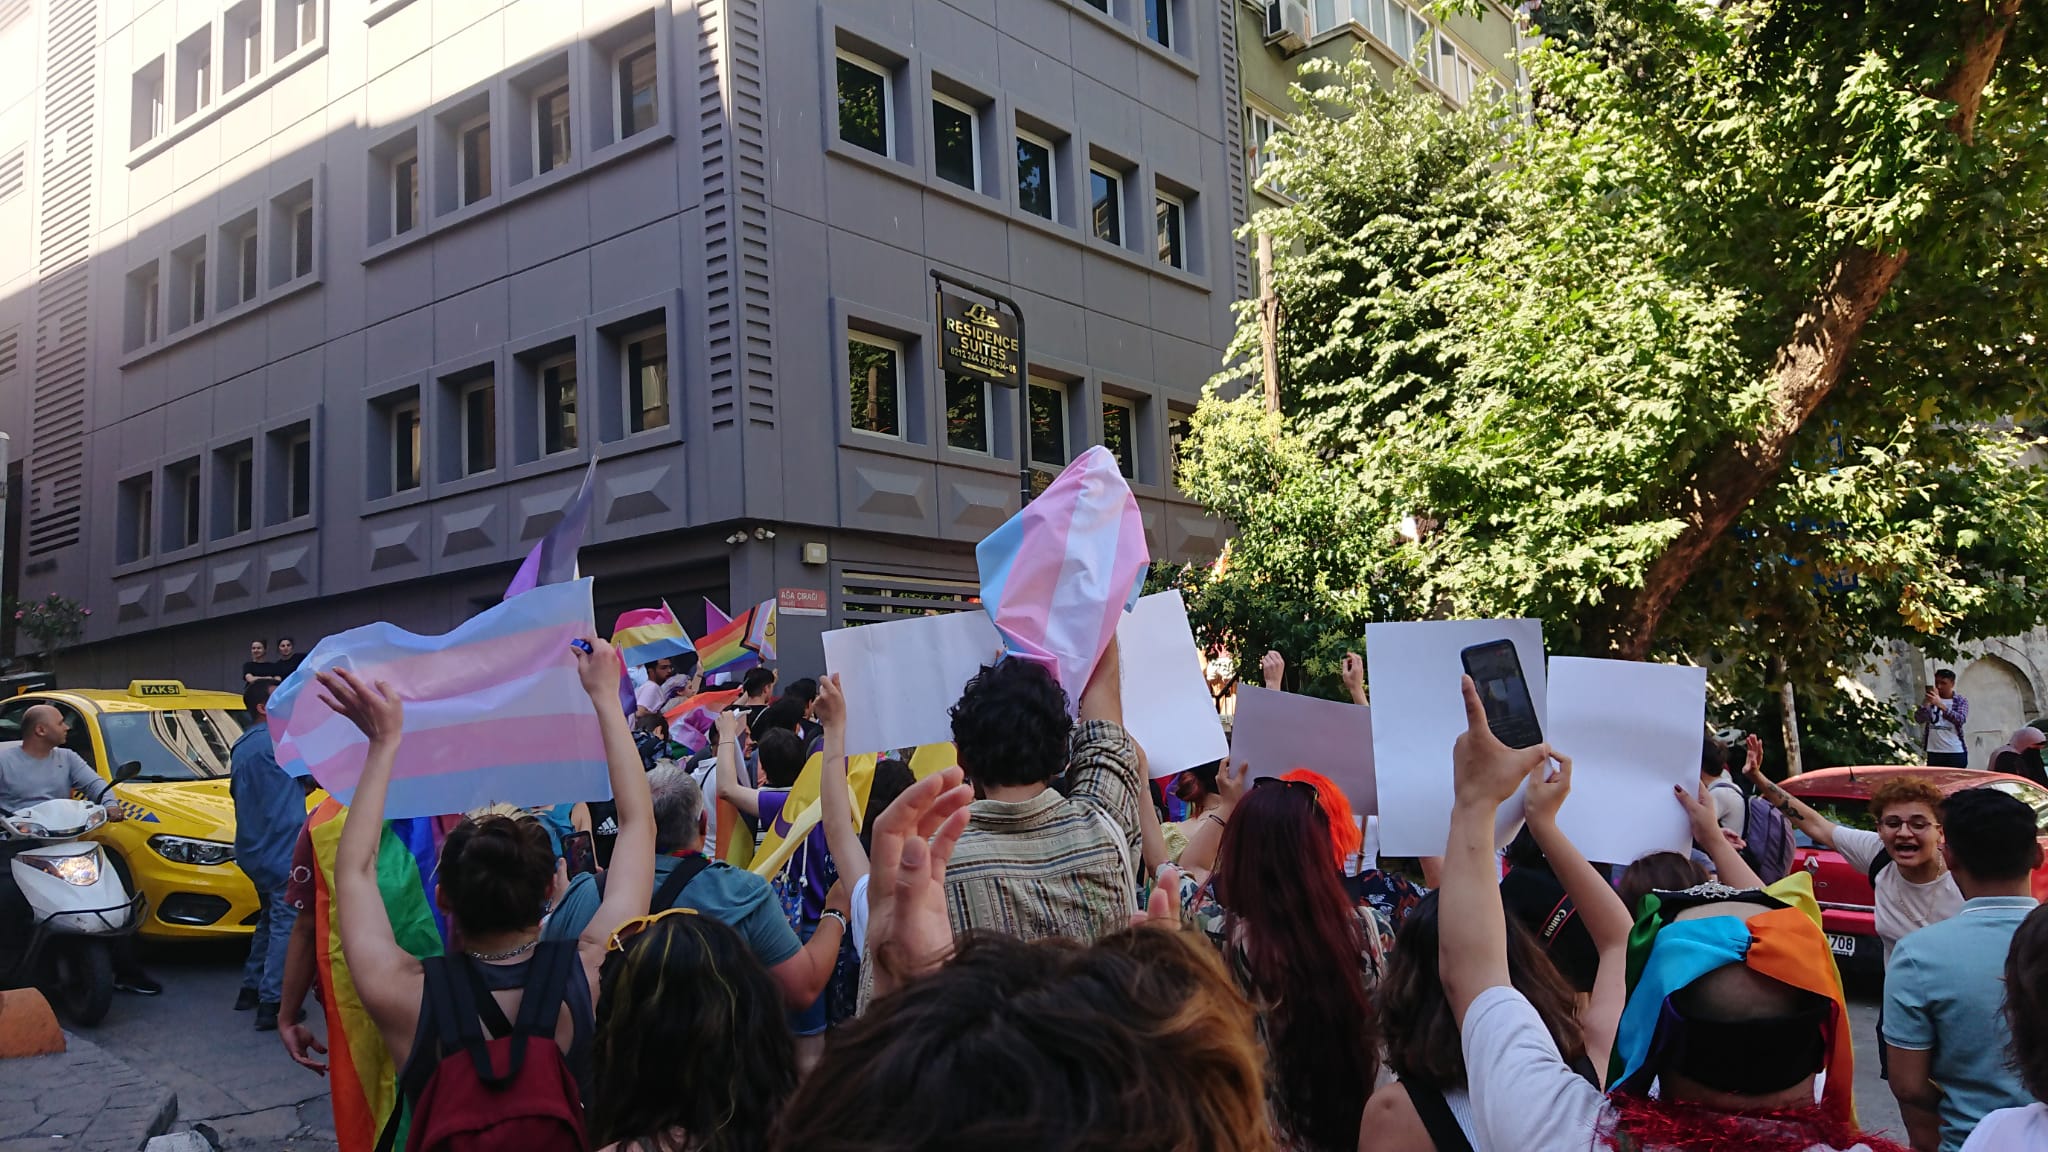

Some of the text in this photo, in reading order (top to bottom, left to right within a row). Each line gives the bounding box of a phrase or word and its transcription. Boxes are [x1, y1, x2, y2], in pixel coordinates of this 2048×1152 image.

[946, 317, 1019, 352] RESIDENCE
[960, 336, 1006, 361] SUITES
[1544, 908, 1567, 937] Canon
[1827, 935, 1853, 950] 708
